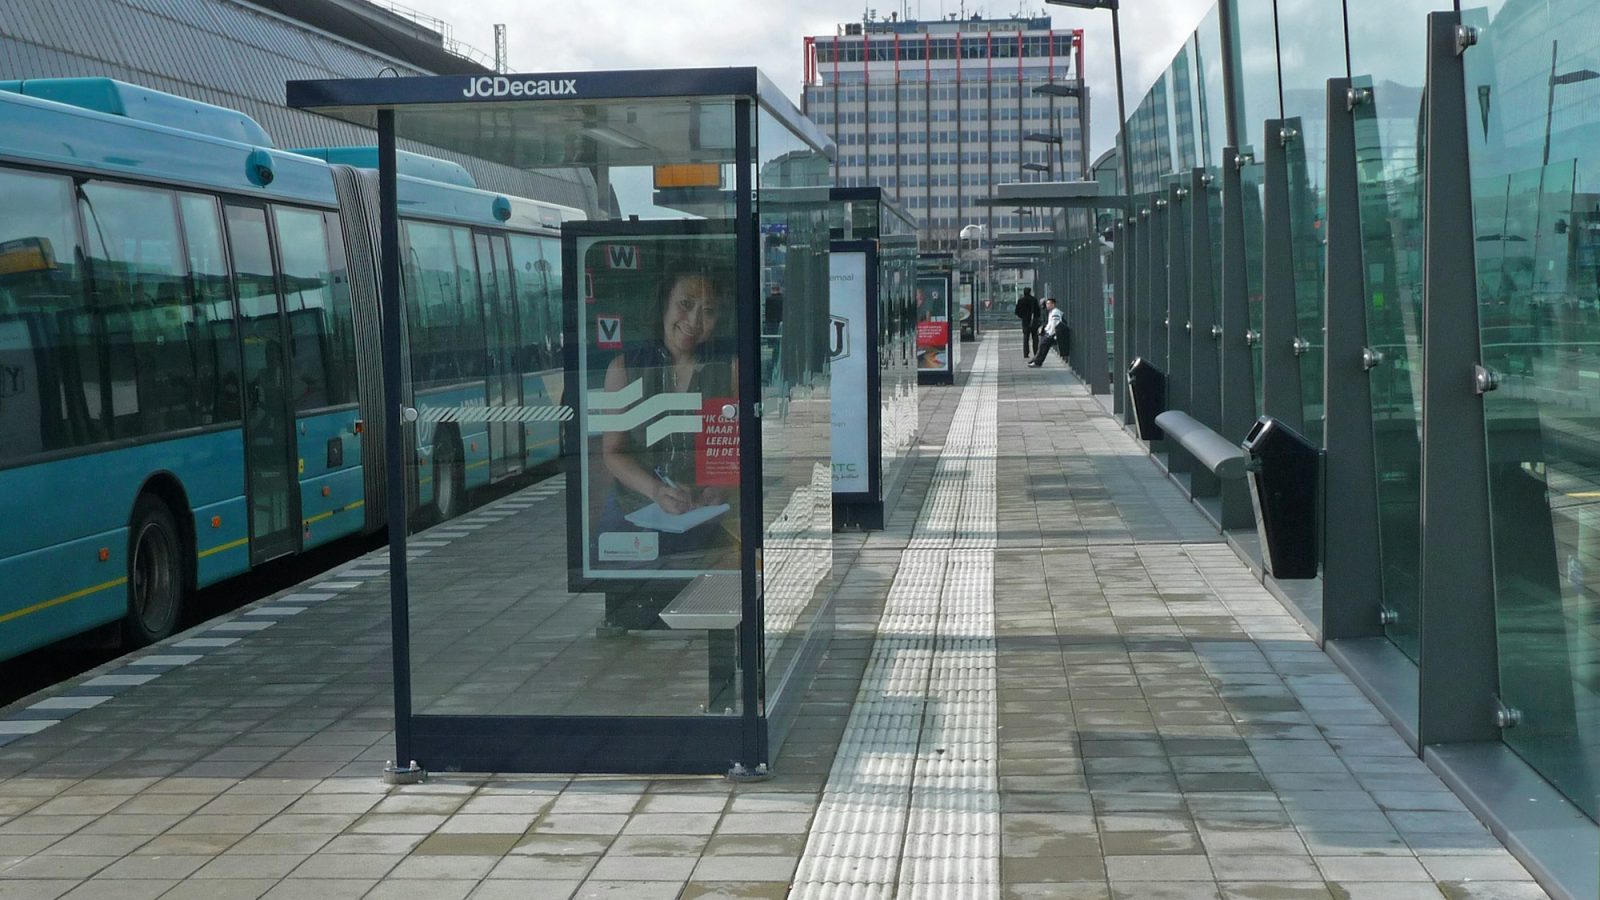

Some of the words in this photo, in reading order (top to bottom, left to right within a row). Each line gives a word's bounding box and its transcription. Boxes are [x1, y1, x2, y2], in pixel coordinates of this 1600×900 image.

[463, 76, 577, 97] JCDecaux
[609, 246, 635, 268] W
[599, 319, 619, 341] V
[706, 425, 733, 434] MAAR
[706, 447, 719, 457] BIJ
[721, 447, 734, 457] DE
